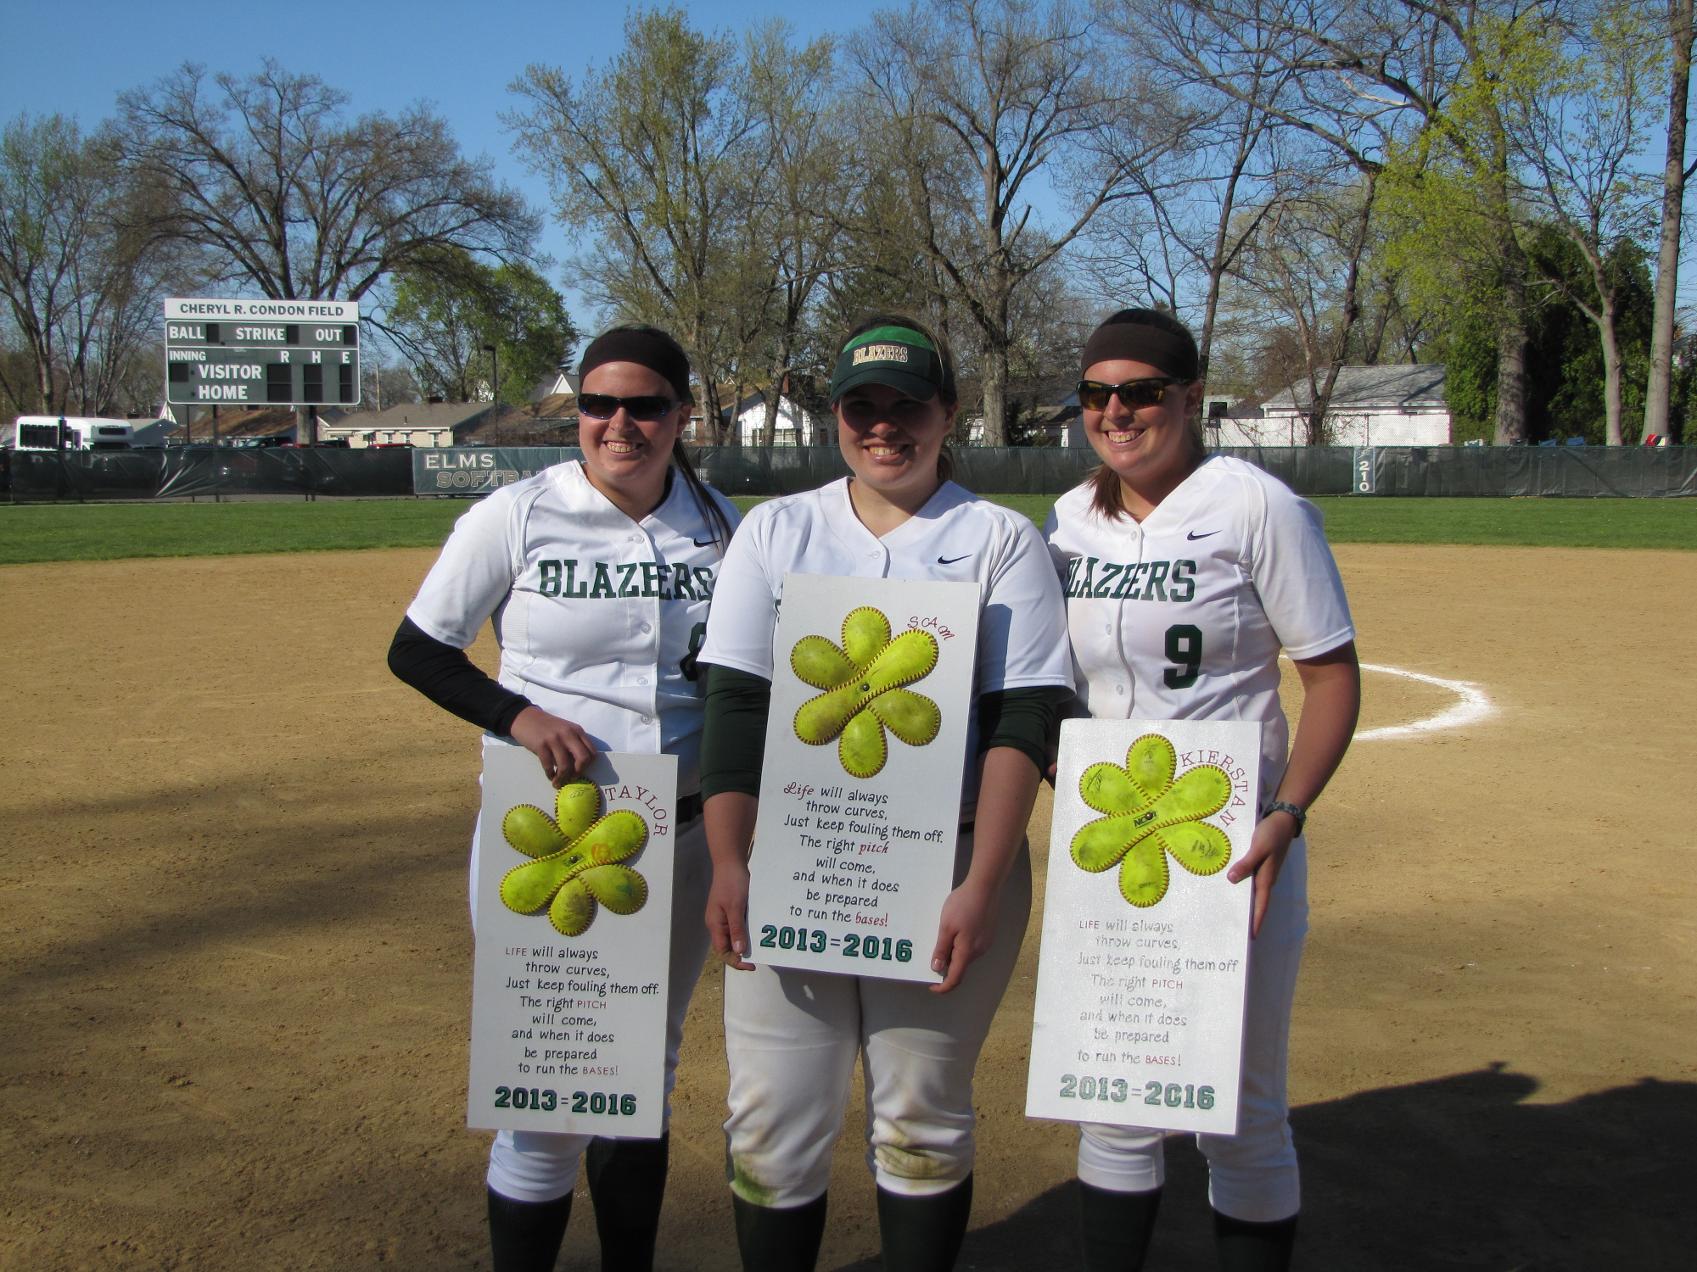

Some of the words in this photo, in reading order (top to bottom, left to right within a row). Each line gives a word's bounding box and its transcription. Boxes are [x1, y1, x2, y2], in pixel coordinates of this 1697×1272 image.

[180, 303, 231, 314] CHERYL
[234, 304, 246, 315] R.
[249, 305, 305, 316] CONDON
[308, 306, 344, 316] FIELD
[169, 326, 205, 340] BALL
[235, 327, 285, 341] STRIKE
[315, 329, 342, 342] OUT
[169, 350, 207, 361] INNING
[280, 351, 290, 363] R
[312, 351, 321, 364] H
[342, 352, 350, 364] E
[852, 344, 908, 366] BLAZERS
[199, 364, 262, 380] VISITOR
[199, 385, 248, 400] HOME
[425, 452, 494, 469] ELMS
[436, 470, 541, 488] SOFTBA
[1359, 461, 1370, 492] 210
[537, 558, 714, 601] BLAZERS
[1163, 624, 1203, 690] 9
[783, 781, 815, 801] Life
[820, 786, 843, 799] will
[847, 789, 889, 807] always
[1180, 749, 1249, 827] KIERSTAN
[605, 785, 669, 837] TAYLOR
[806, 800, 840, 814] throw
[845, 806, 888, 820] curves,
[783, 814, 810, 827] Just
[816, 817, 845, 833] keep
[849, 821, 889, 840] fouling
[892, 826, 921, 840] them
[924, 830, 944, 844] off.
[800, 834, 822, 848] The
[826, 837, 856, 854] right
[858, 841, 890, 855] pitch
[816, 856, 837, 869] will
[792, 870, 816, 882] and
[822, 874, 853, 888] when
[858, 877, 867, 889] it
[871, 878, 900, 892] does
[806, 889, 821, 901] be
[825, 892, 879, 907] prepared
[789, 905, 803, 917] to
[807, 908, 828, 921] run
[831, 909, 852, 923] the
[854, 912, 889, 927] bases!
[1079, 920, 1100, 930] LIFE
[1105, 919, 1128, 932] will
[1132, 919, 1174, 935] always
[1095, 935, 1132, 948] throw
[505, 947, 528, 957] LIFE
[532, 946, 554, 958] will
[558, 947, 599, 962] always
[525, 962, 560, 975] throw
[566, 965, 610, 979] curves,
[1077, 952, 1101, 965] Just
[1106, 953, 1135, 969] keep
[1139, 955, 1182, 975] fouling
[1184, 958, 1216, 971] them
[506, 977, 531, 989] Just
[537, 978, 564, 993] keep
[568, 980, 607, 997] fouling
[610, 983, 638, 995] them
[641, 983, 660, 995] off.
[1091, 973, 1113, 987] The
[1118, 976, 1146, 992] right
[1151, 979, 1184, 989] PITCH
[520, 995, 542, 1008] The
[546, 996, 574, 1013] right
[577, 1000, 607, 1009] PITCH
[1100, 993, 1123, 1006] will
[532, 1013, 554, 1025] will
[561, 1016, 597, 1026] come,
[1079, 1009, 1103, 1022] and
[1108, 1011, 1140, 1024] when
[1144, 1012, 1153, 1025] it
[1157, 1013, 1188, 1026] does
[511, 1028, 533, 1040] and
[540, 1029, 570, 1041] when
[575, 1030, 584, 1041] it
[587, 1031, 615, 1043] does
[1093, 1027, 1108, 1040] be
[1114, 1031, 1169, 1044] prepared
[524, 1046, 538, 1058] be
[545, 1048, 598, 1062] prepared
[1077, 1049, 1090, 1062] to
[1095, 1051, 1117, 1063] run
[1121, 1051, 1141, 1064] the
[1145, 1053, 1182, 1067] BASES!
[518, 1062, 530, 1074] to
[536, 1065, 556, 1075] run
[559, 1063, 578, 1075] the
[582, 1065, 619, 1076] BASES!
